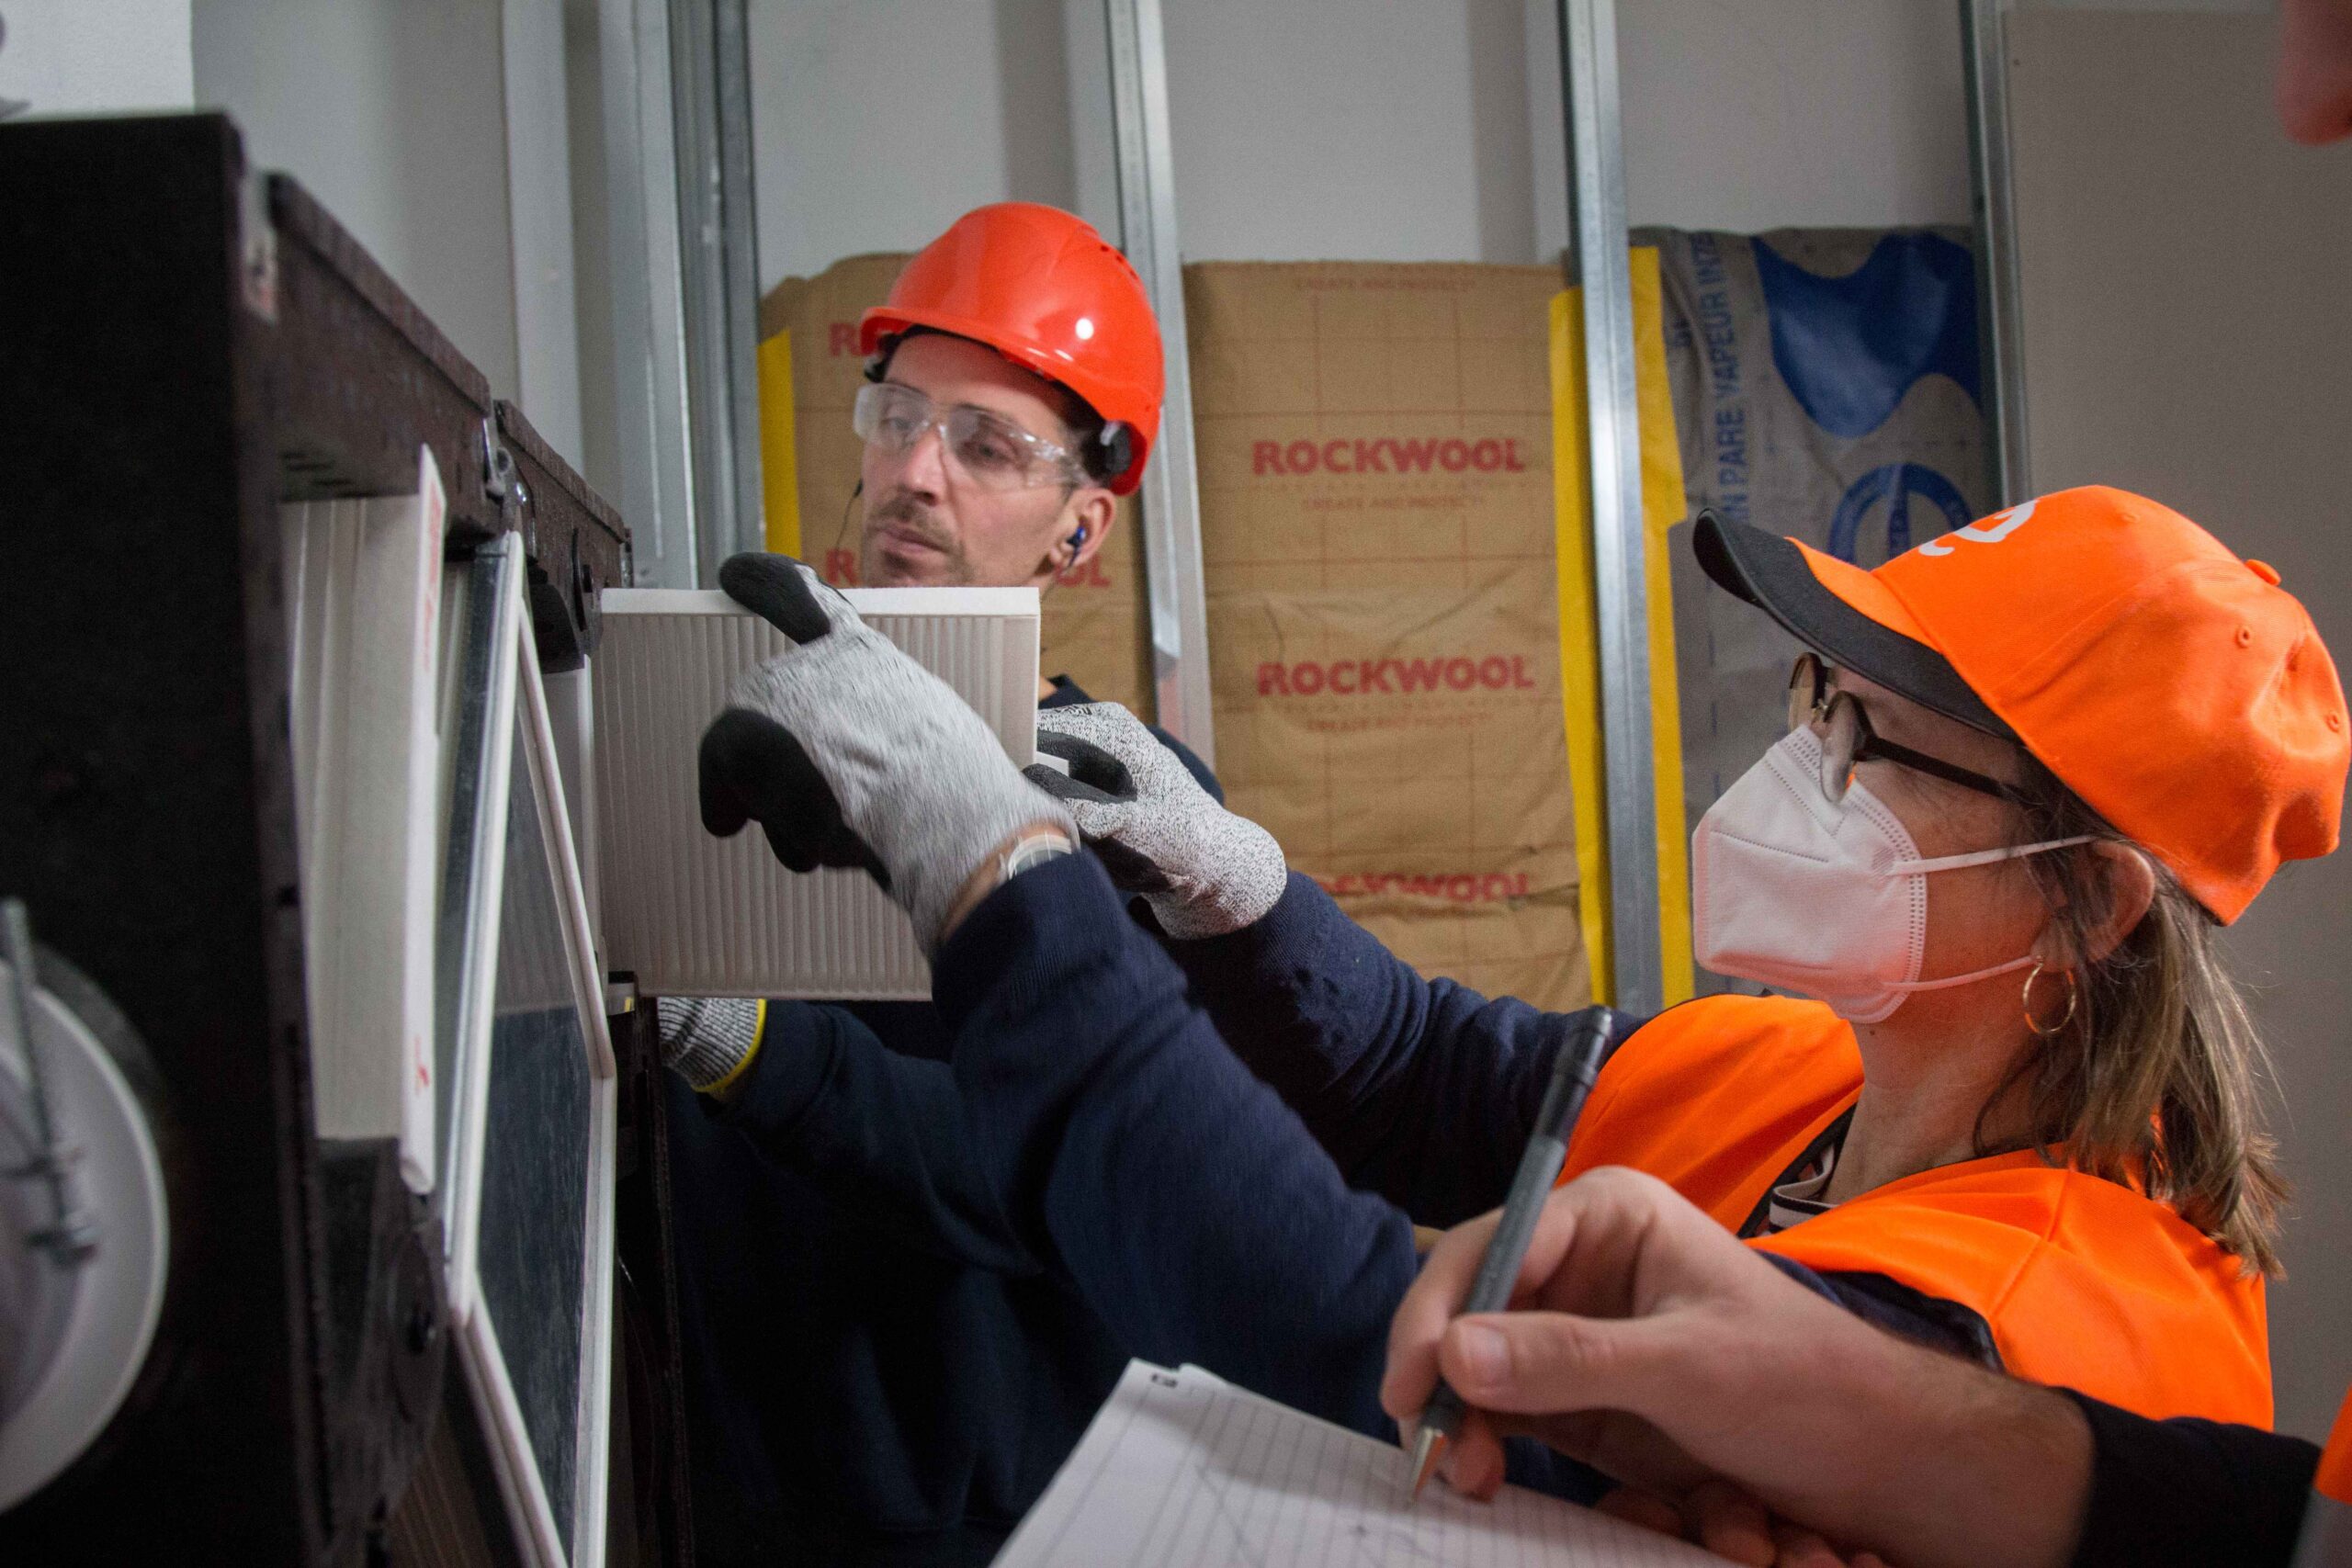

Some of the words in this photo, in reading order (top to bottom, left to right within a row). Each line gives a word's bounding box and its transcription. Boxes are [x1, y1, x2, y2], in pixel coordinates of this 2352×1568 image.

[1701, 291, 1740, 400] VAPEUR
[1250, 437, 1526, 477] ROCKWOOL
[1714, 410, 1747, 486] PARE
[1256, 653, 1537, 696] ROCKWOOL
